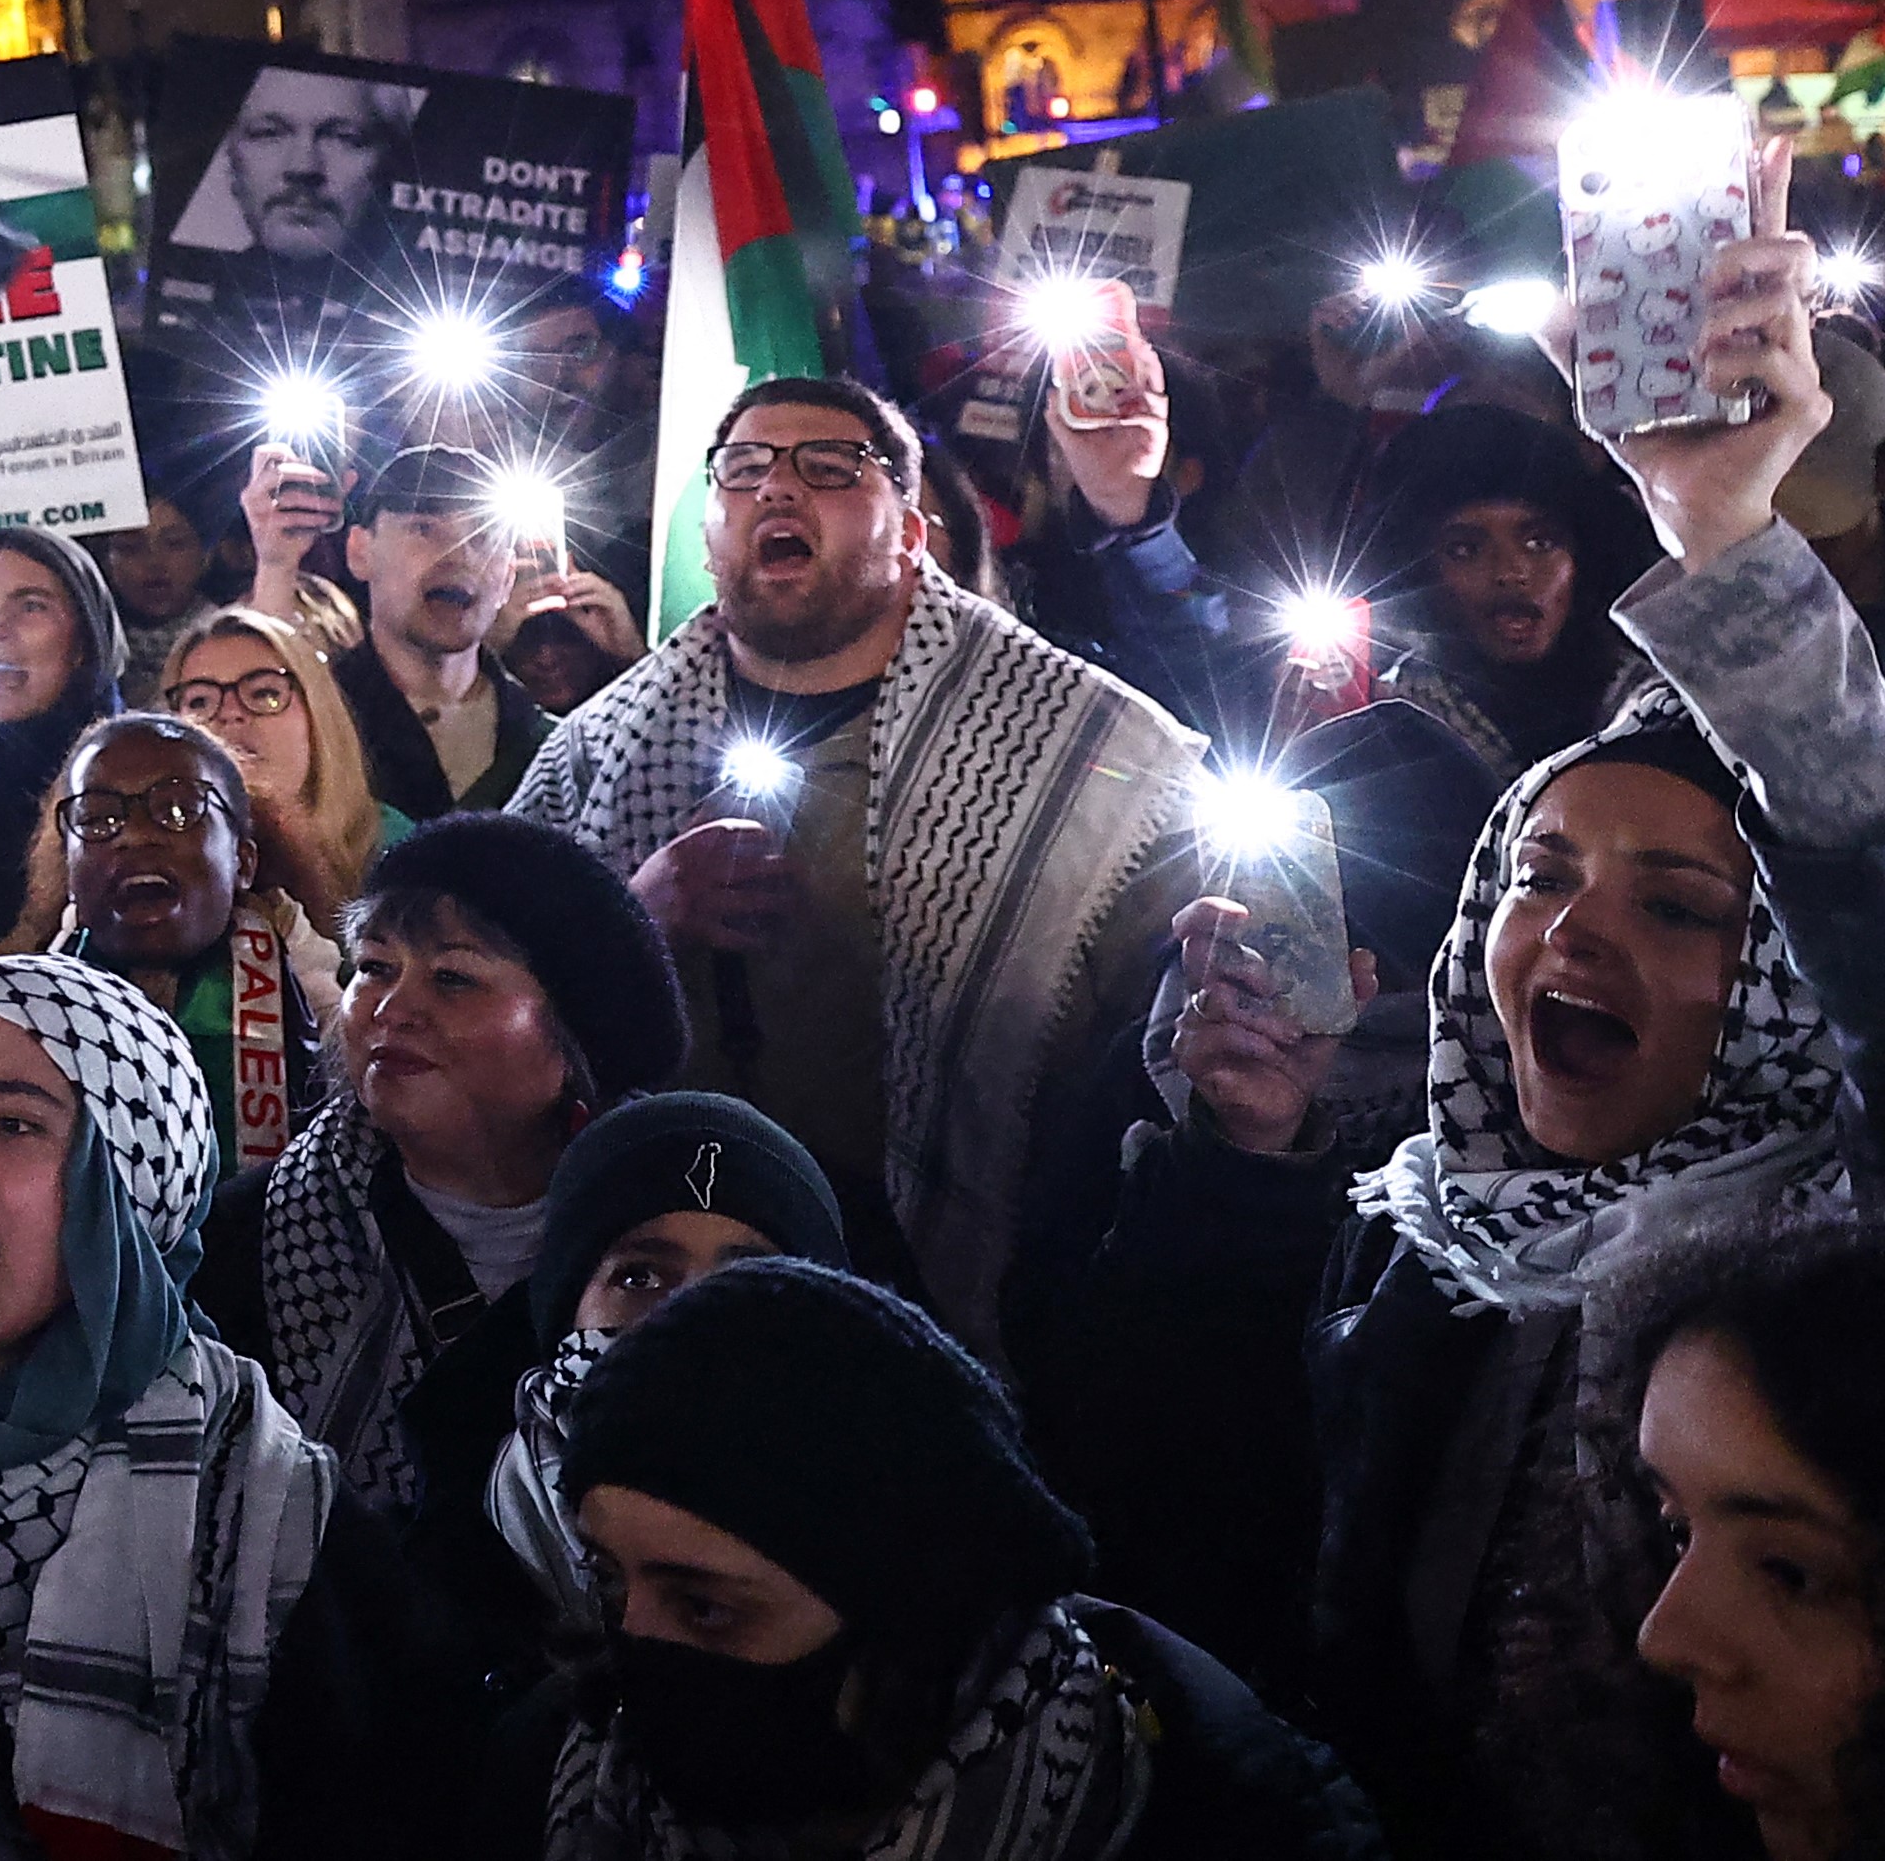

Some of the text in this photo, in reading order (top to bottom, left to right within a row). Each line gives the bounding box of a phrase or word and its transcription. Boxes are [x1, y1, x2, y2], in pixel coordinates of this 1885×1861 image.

[484, 155, 591, 195] DON'T
[391, 180, 588, 235] EXTRADITE
[416, 224, 584, 274] ASSANGE
[236, 928, 287, 1159] PALEST
